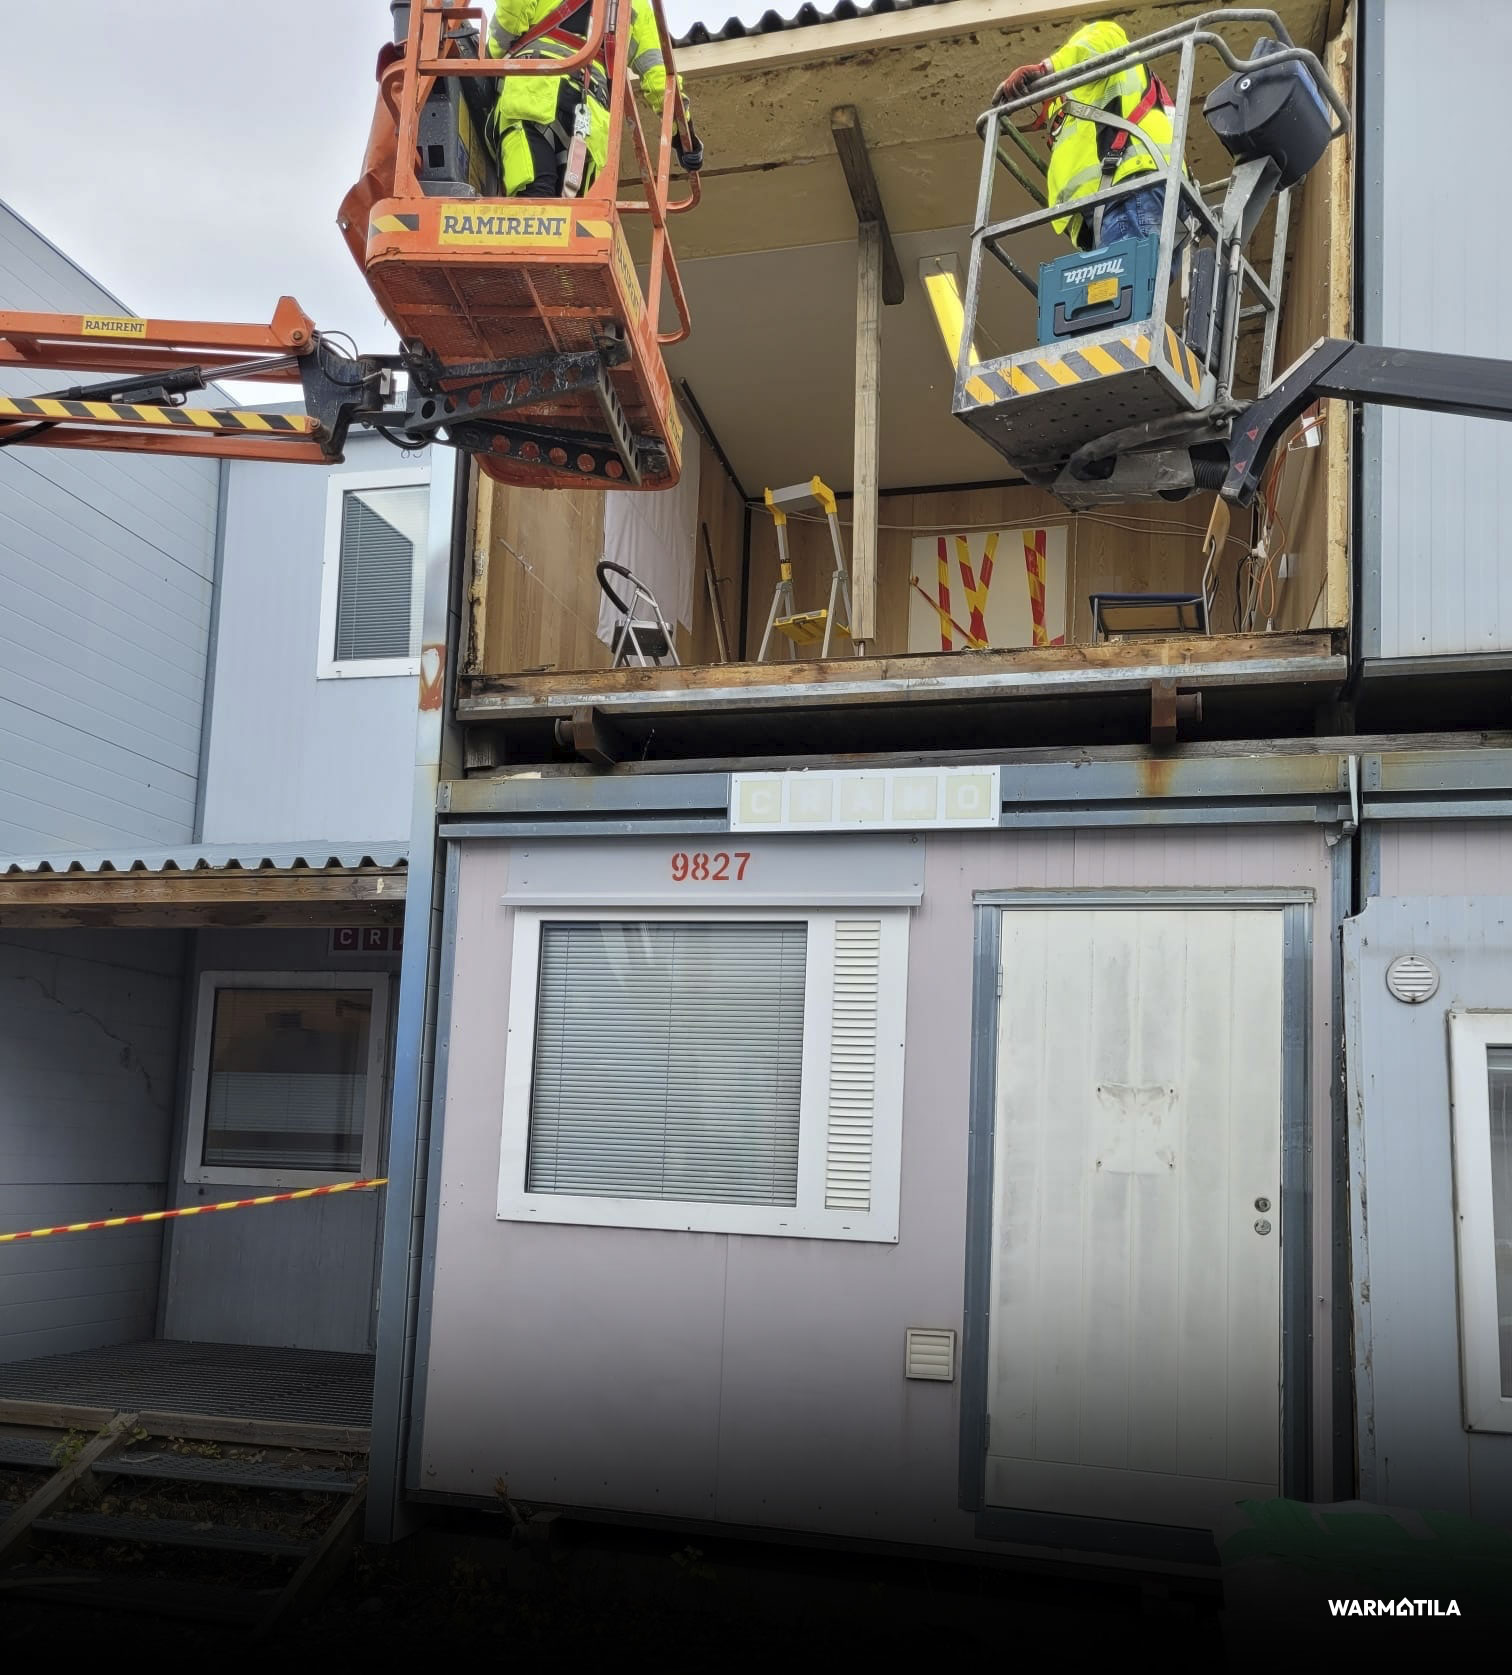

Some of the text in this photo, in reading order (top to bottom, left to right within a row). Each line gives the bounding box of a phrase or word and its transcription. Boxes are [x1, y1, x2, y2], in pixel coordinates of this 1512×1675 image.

[443, 215, 567, 236] RAMIRENT
[85, 320, 145, 332] RAMIRENT
[671, 852, 751, 882] 9827
[340, 929, 404, 945] CR
